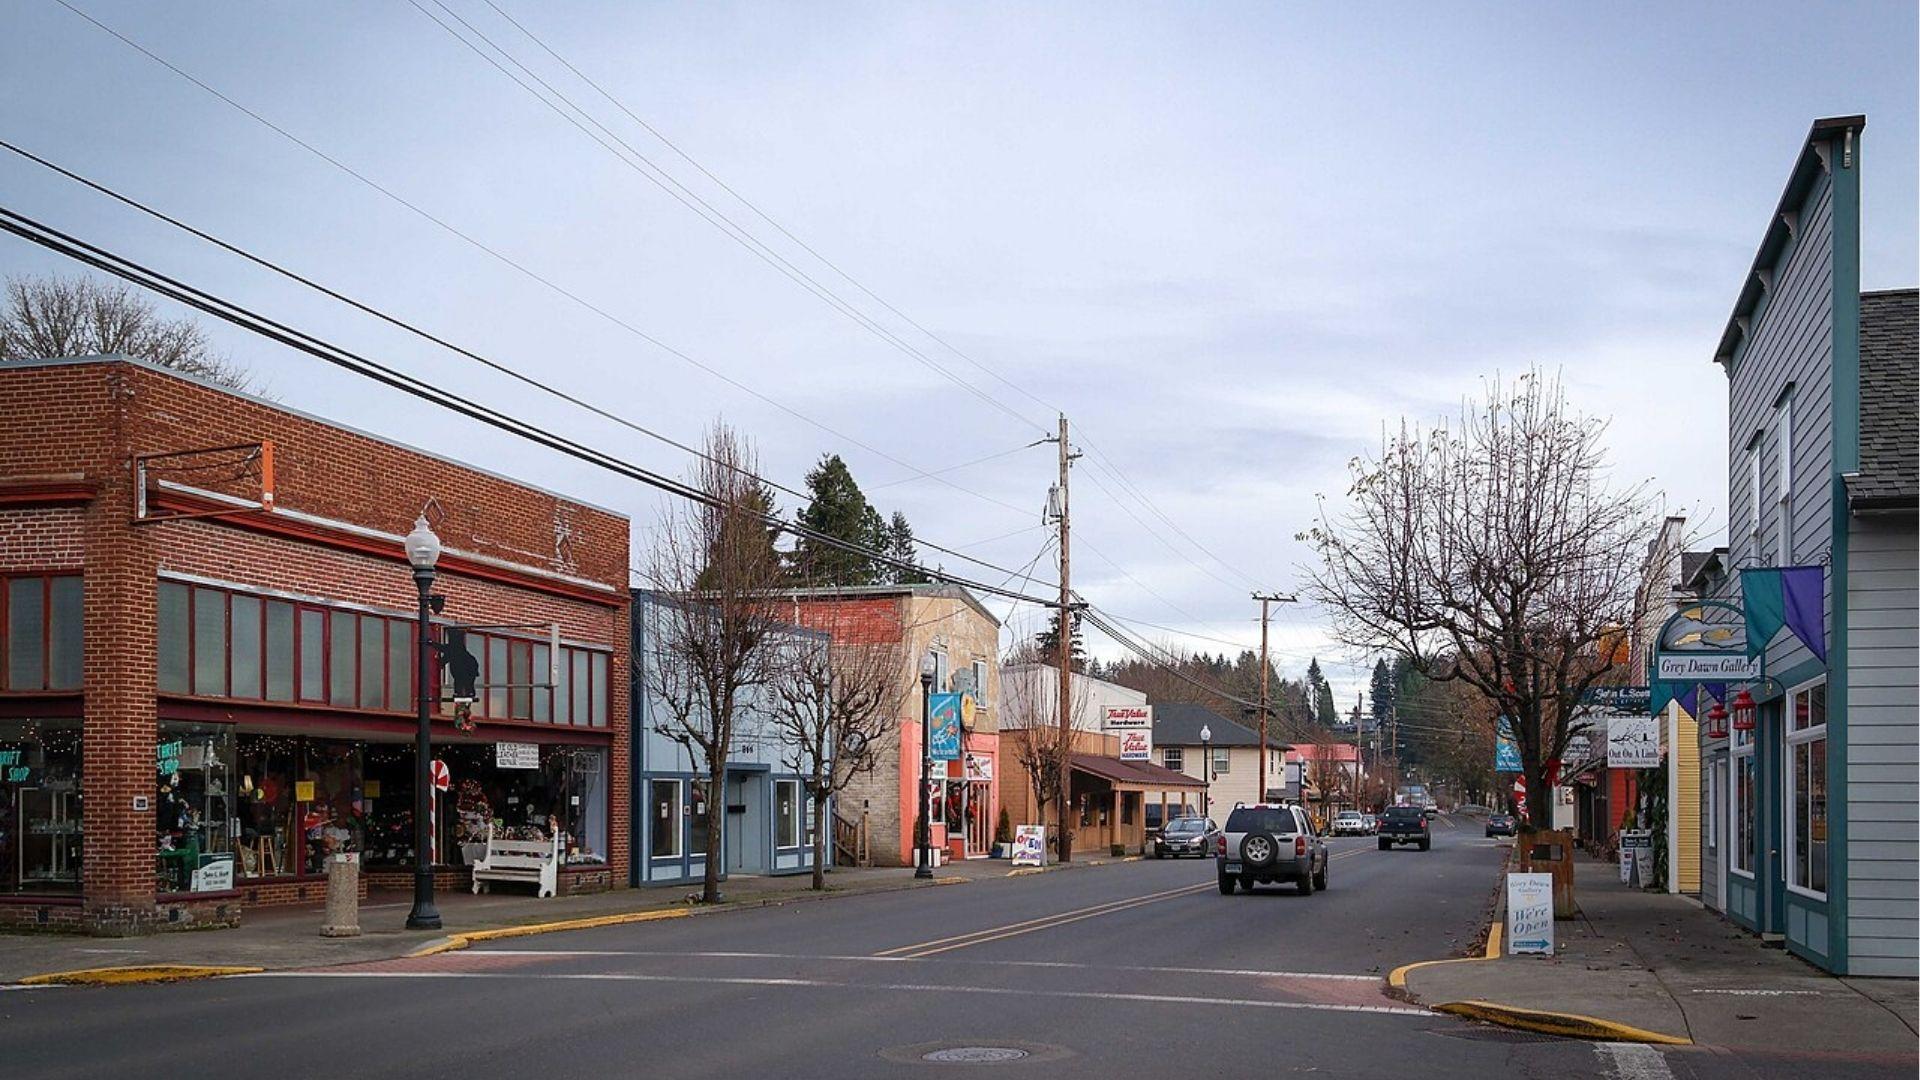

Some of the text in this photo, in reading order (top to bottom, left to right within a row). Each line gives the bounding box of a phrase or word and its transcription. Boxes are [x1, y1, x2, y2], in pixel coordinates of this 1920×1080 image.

[1661, 657, 1759, 676] Grey Dawn Gallery
[1016, 834, 1042, 850] OPEN
